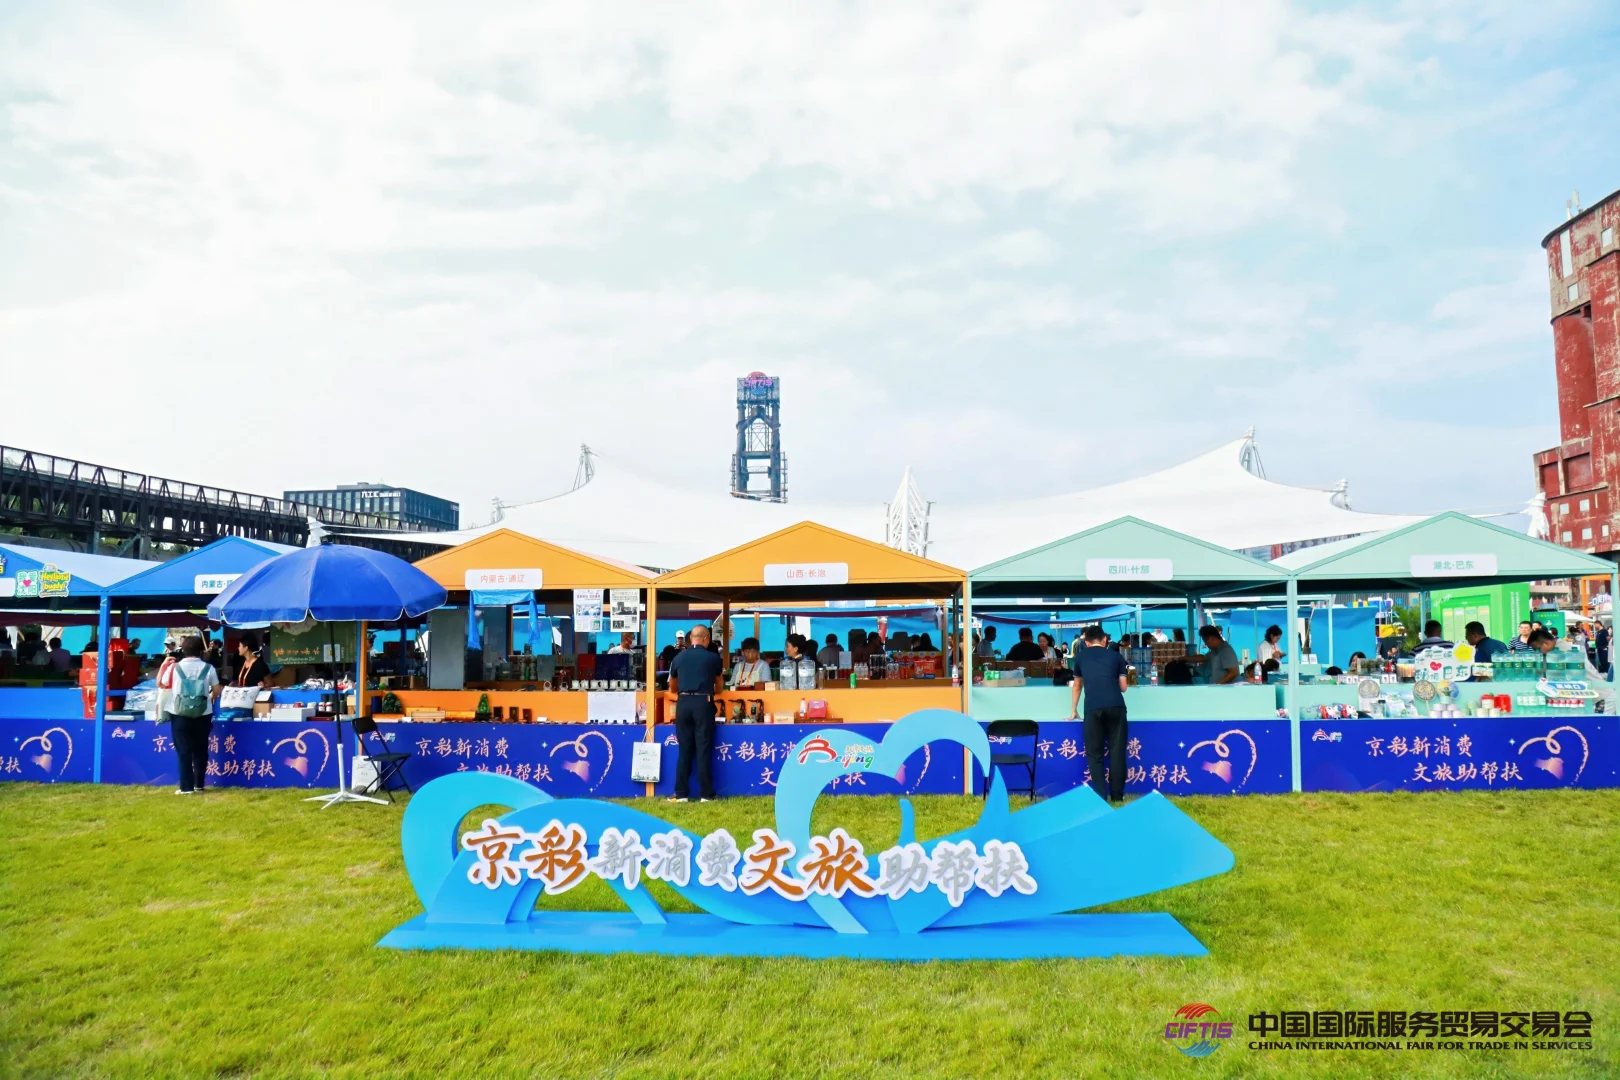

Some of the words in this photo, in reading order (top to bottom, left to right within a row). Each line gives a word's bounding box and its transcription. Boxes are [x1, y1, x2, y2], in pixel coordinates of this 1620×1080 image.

[480, 574, 525, 584] 内蒙古·通辽
[786, 568, 826, 579] 山西·长治
[151, 734, 237, 755] 京消费
[415, 736, 510, 759] 京彩新消费
[1036, 737, 1143, 761] 京彩费
[1366, 734, 1473, 759] 京彩新消费
[1412, 761, 1524, 786] 文旅助帮扶
[464, 824, 1028, 902] 京彩新消费文旅助帮扶
